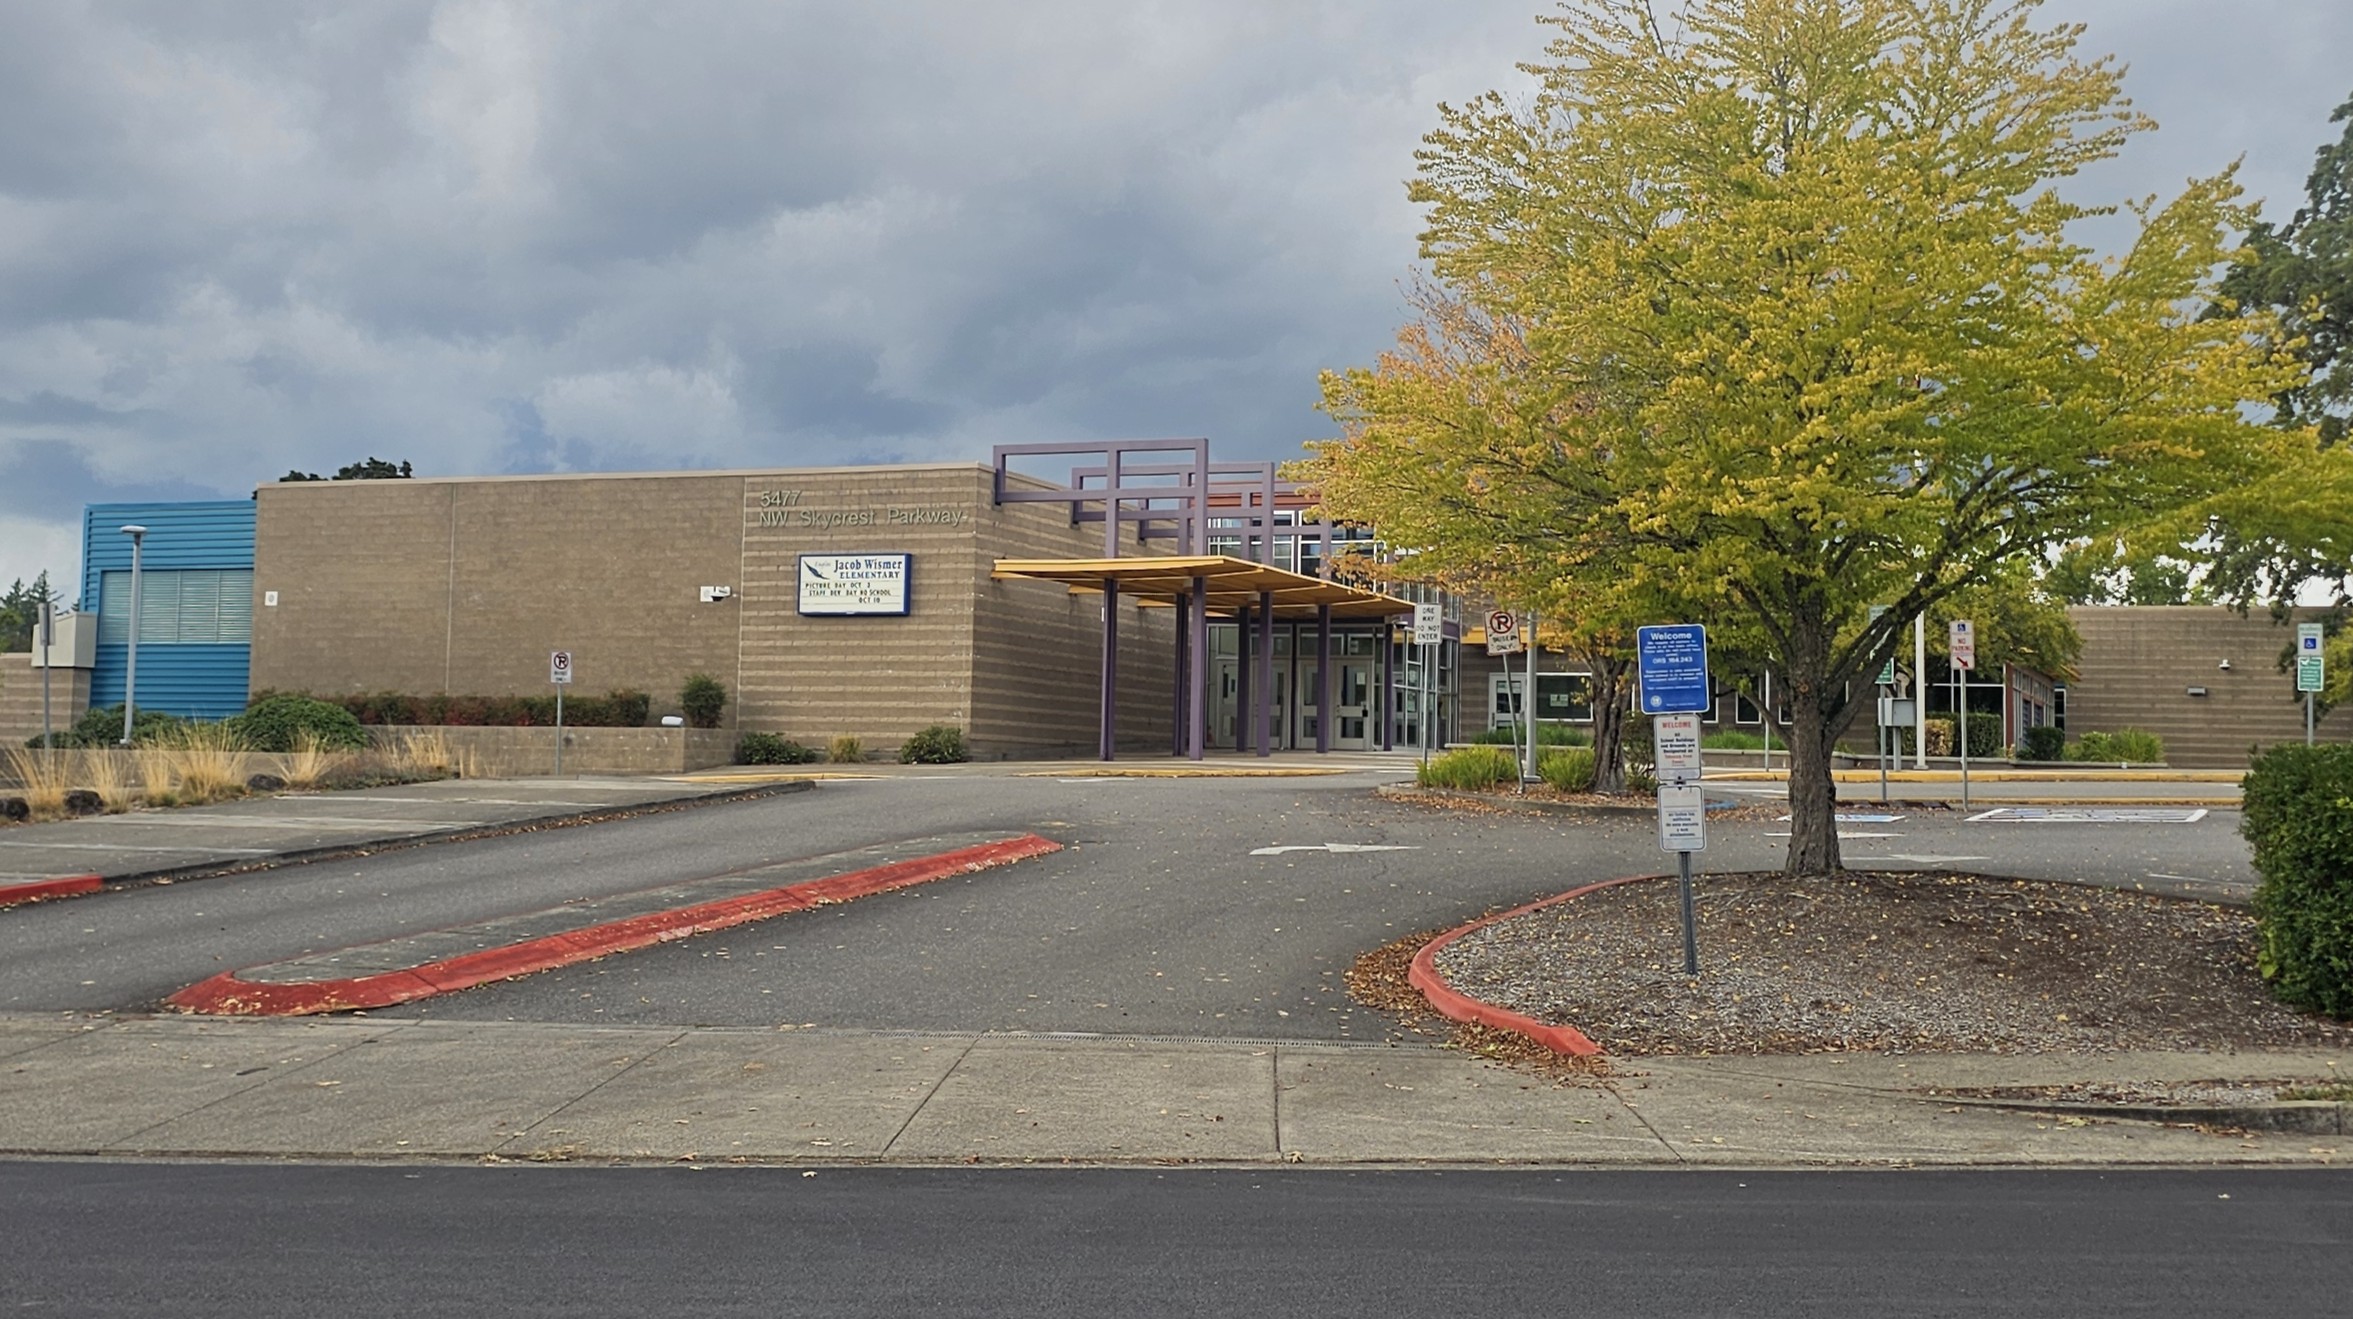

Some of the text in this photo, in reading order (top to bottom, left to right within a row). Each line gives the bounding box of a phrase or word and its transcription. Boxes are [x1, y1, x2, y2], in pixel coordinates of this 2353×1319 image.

[760, 490, 801, 507] 5477
[759, 507, 963, 529] NW Skycrest Parkway
[834, 559, 861, 573] Jacob
[864, 558, 902, 570] Wismer
[840, 571, 900, 579] ELEMENTARY
[1650, 632, 1692, 640] Welcome
[1662, 721, 1692, 729] WELCOME
